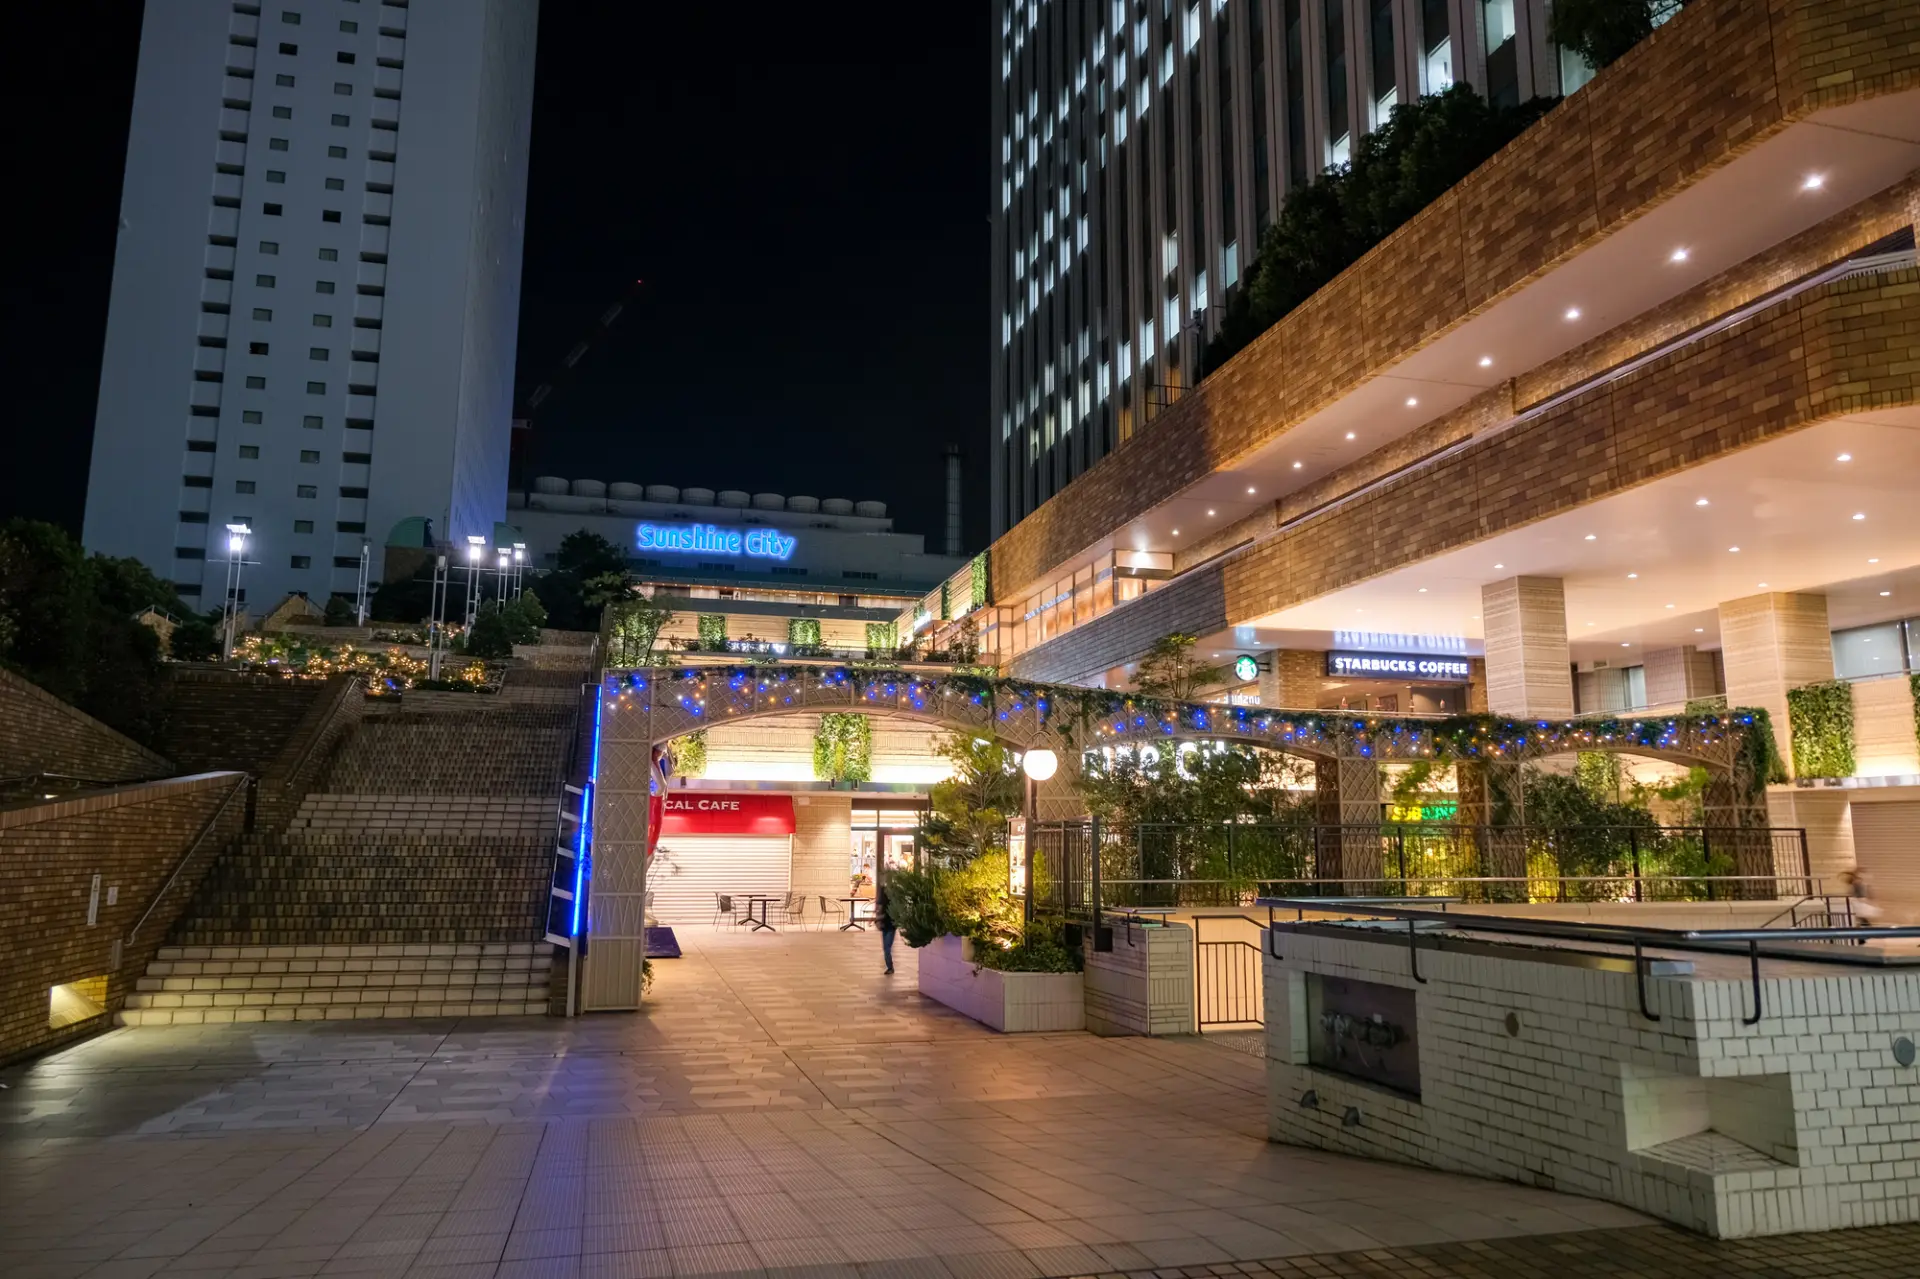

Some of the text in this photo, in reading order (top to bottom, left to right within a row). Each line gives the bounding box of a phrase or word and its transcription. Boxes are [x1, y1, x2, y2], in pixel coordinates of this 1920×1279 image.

[639, 524, 794, 558] Sunshine City
[1335, 657, 1468, 674] STARBUCKS COFFEE
[698, 800, 740, 811] CAFE
